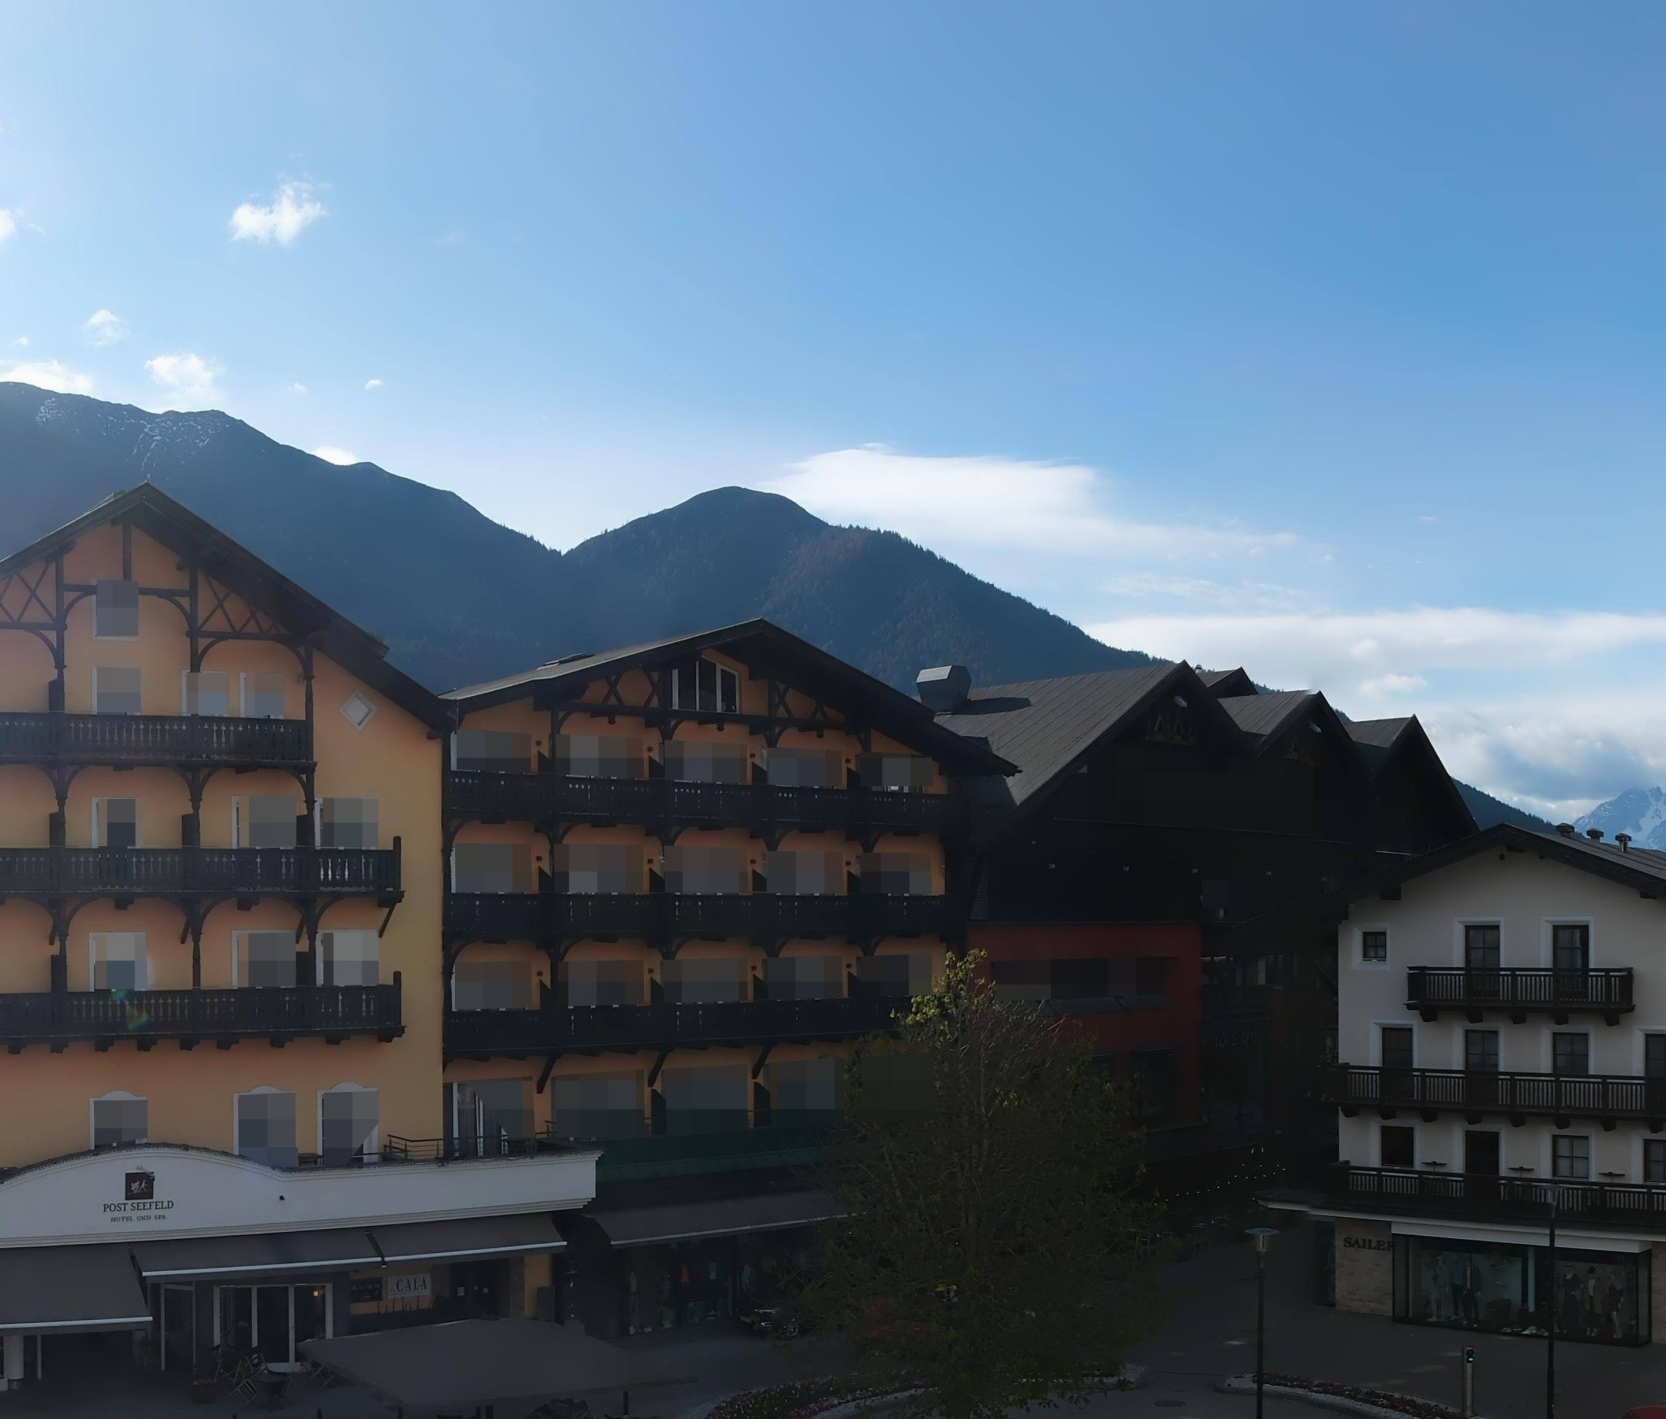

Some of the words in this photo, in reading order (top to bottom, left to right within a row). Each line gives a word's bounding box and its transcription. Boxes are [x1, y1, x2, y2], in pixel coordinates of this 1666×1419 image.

[103, 1202, 128, 1212] POST
[130, 1200, 174, 1212] SEEFELD
[396, 1276, 427, 1293] CALA
